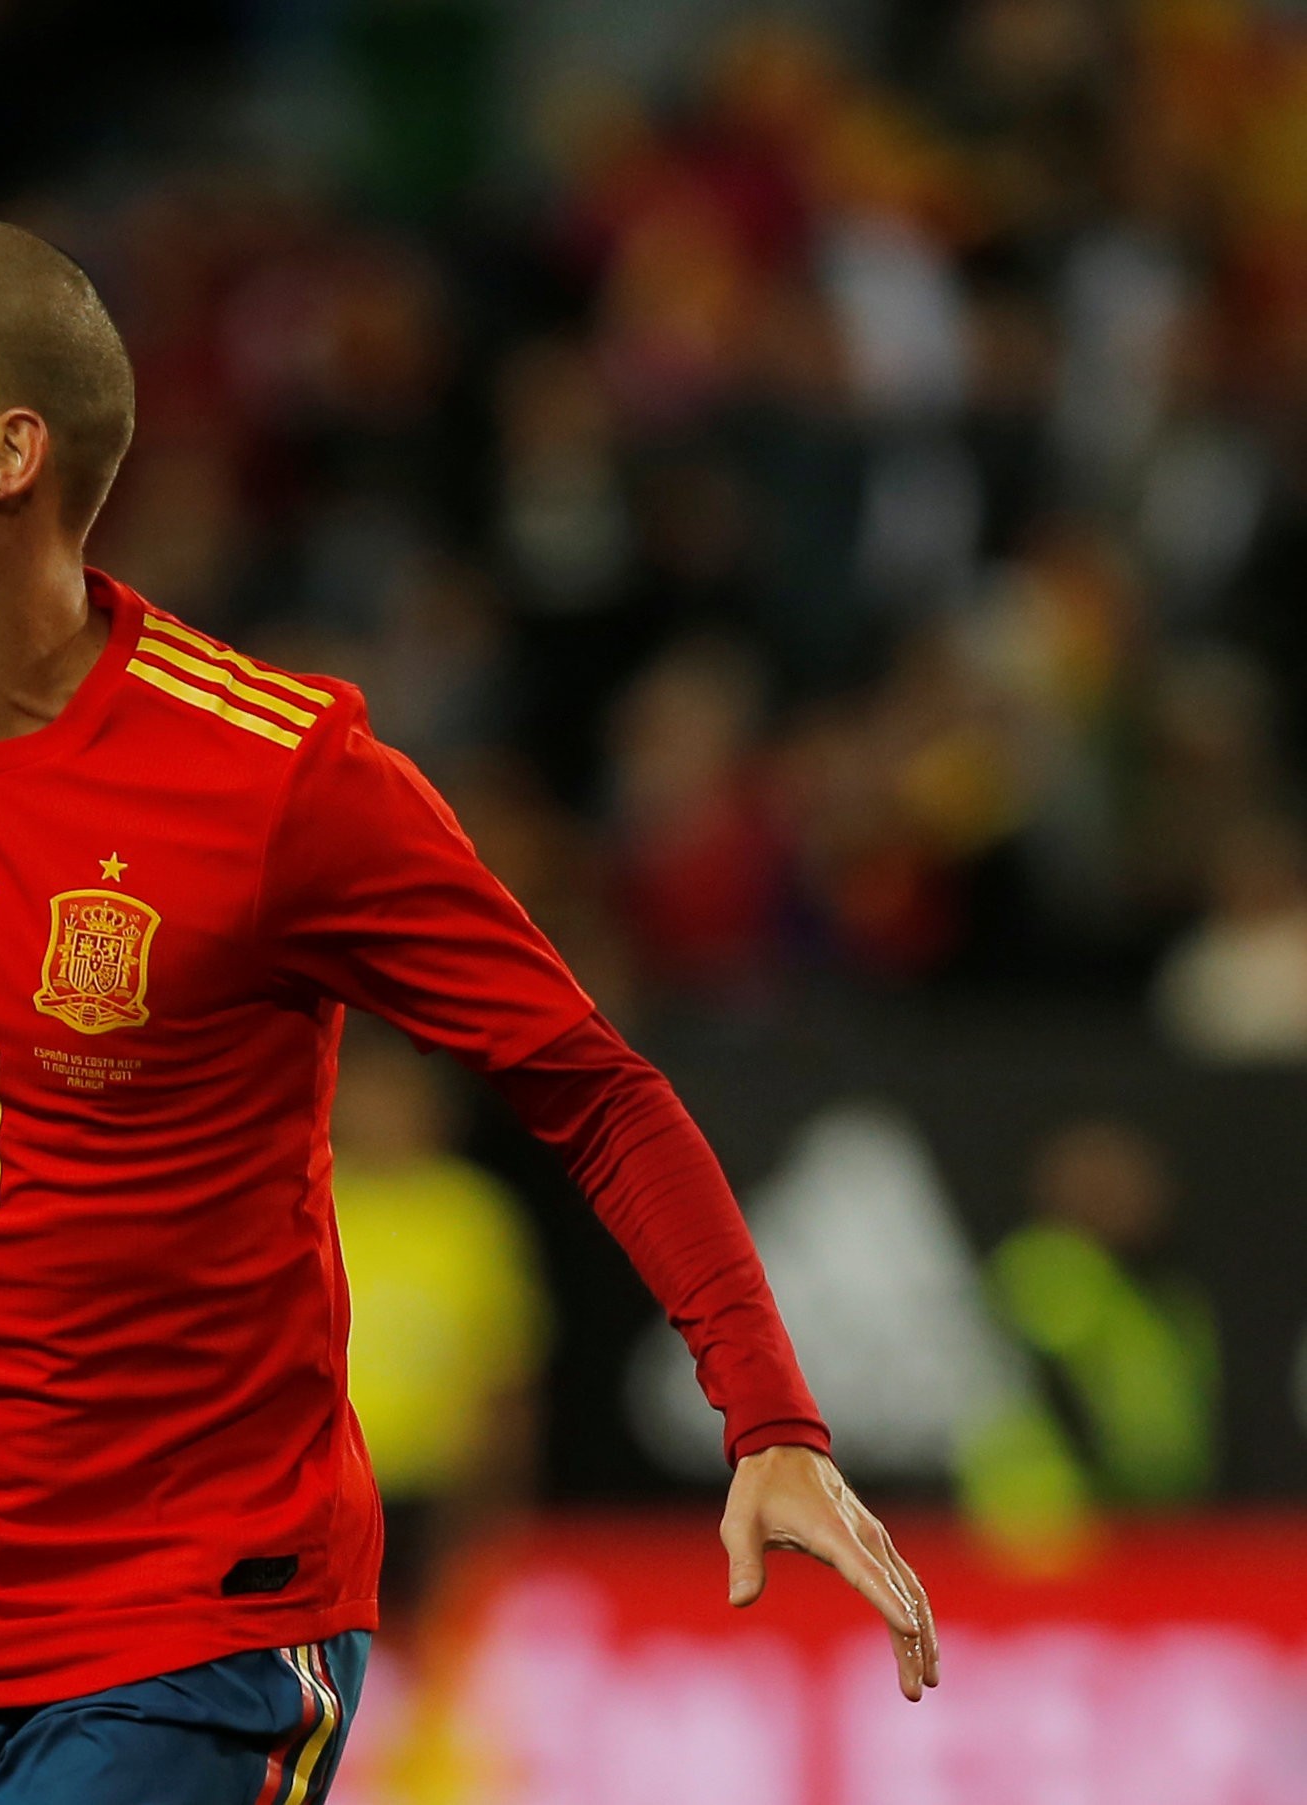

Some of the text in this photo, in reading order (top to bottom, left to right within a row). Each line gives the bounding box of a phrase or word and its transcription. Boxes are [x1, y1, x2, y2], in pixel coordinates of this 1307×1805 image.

[42, 1060, 50, 1071] 11
[52, 1062, 106, 1080] NOVIEMBRE
[85, 1056, 115, 1068] COSTA
